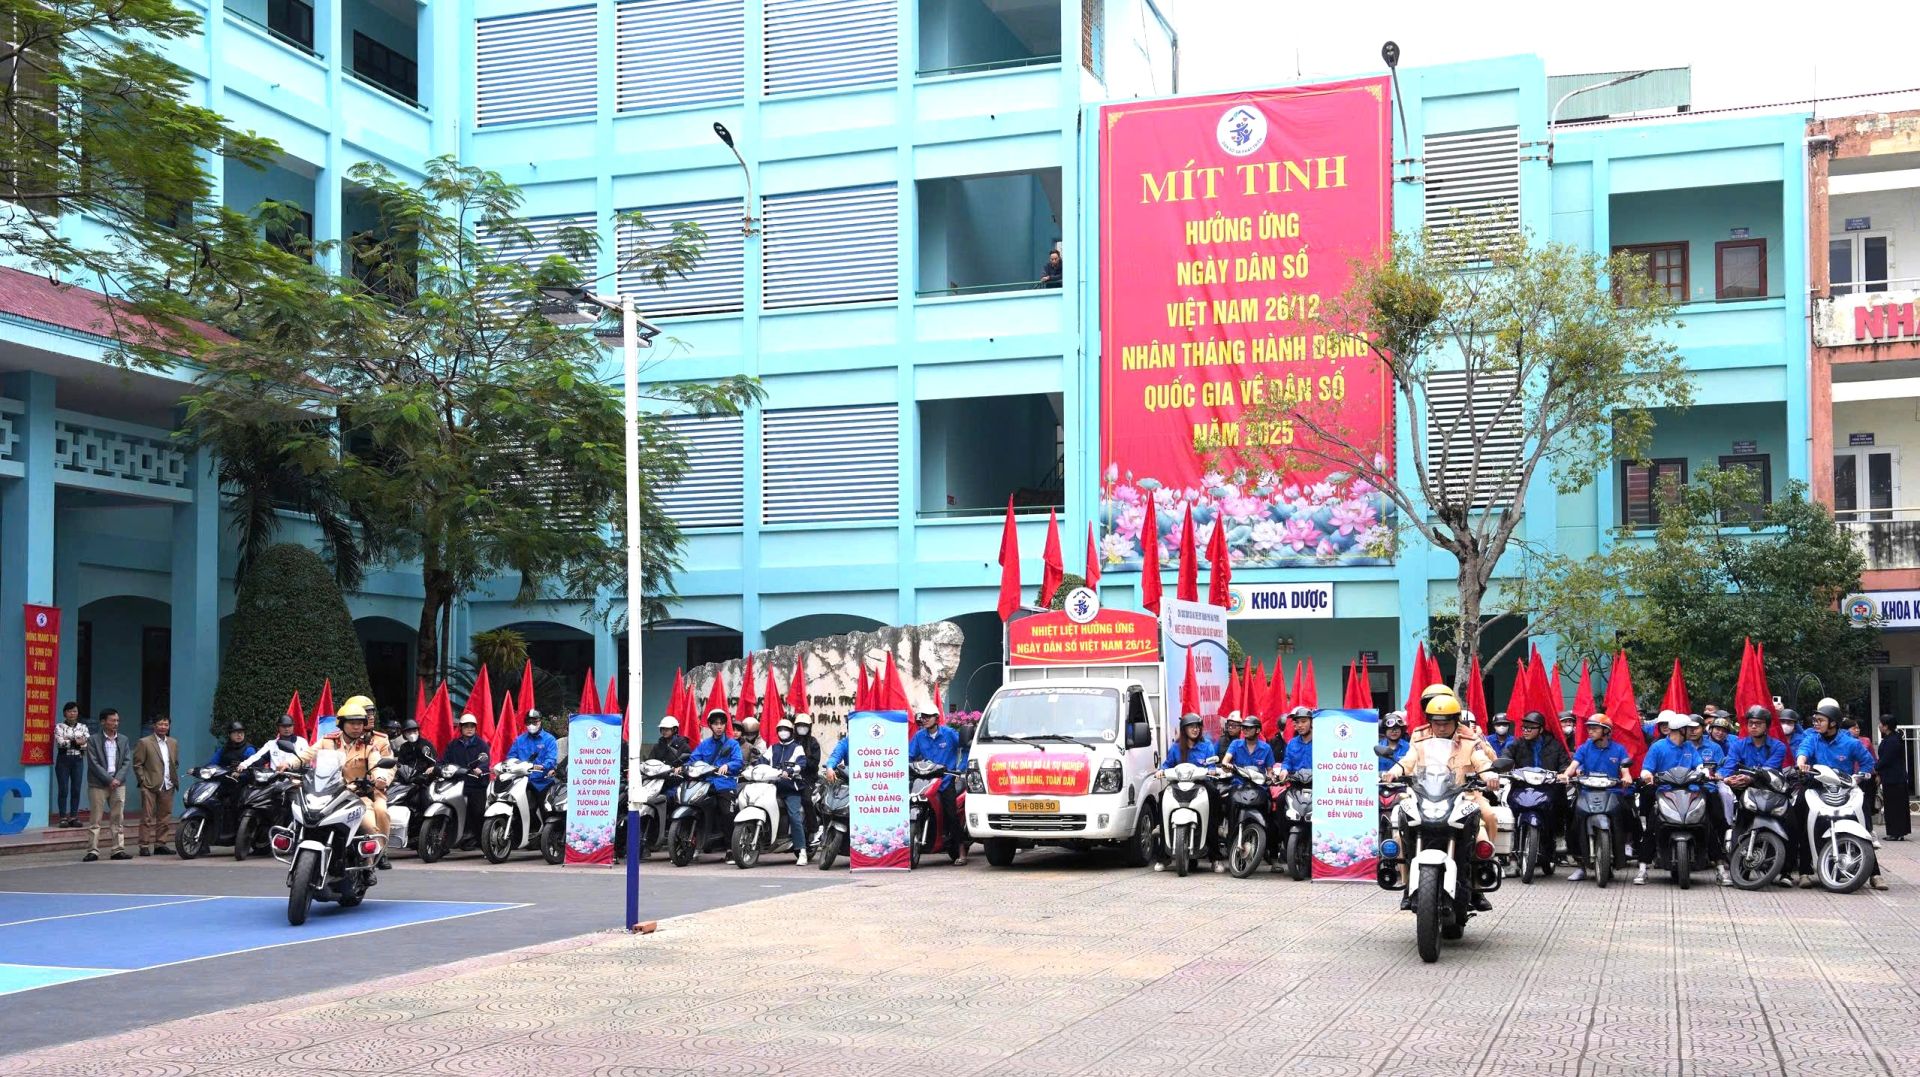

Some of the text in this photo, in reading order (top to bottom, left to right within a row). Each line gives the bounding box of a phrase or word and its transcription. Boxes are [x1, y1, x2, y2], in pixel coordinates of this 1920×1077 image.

[1140, 155, 1348, 204] MÍT TINH
[1186, 210, 1299, 245] HƯỞNG ỨNG
[1177, 244, 1309, 286] NGÀY DÂN SỐ
[1167, 294, 1320, 330] VIỆT NAM 26/12
[1855, 303, 1920, 340] NH
[1122, 339, 1176, 370] NHÂN
[1182, 336, 1246, 367] THÁNG
[1252, 333, 1307, 363] HÀNH
[1144, 375, 1196, 412] QUỐC
[1202, 381, 1235, 407] GIA
[1240, 371, 1265, 406] VỀ
[1318, 366, 1346, 402] SỐ
[1252, 589, 1328, 612] KHOA DƯỢC
[1881, 600, 1911, 620] KHOA
[1032, 624, 1057, 637] NHIỆT
[1060, 624, 1078, 638] LIỆT
[1081, 622, 1113, 635] HƯỞNG
[1017, 638, 1152, 654] NGÀY DÂN SỐ VIỆT NAM 26/12
[857, 747, 900, 756] CÔNG TÁC
[863, 757, 894, 767] DÂN SỐ
[1335, 762, 1358, 770] CÔNG
[1360, 762, 1374, 770] TÁC
[598, 767, 610, 775] TỐT
[853, 771, 861, 779] LÀ
[876, 770, 905, 780] NGHIỆP
[1332, 773, 1359, 782] DÂN SỐ
[872, 781, 889, 790] CỦA
[1327, 786, 1336, 794] LÀ
[855, 794, 876, 802] TOÀN
[1335, 798, 1353, 806] PHÁT
[859, 805, 900, 813] TOÀN DÂN
